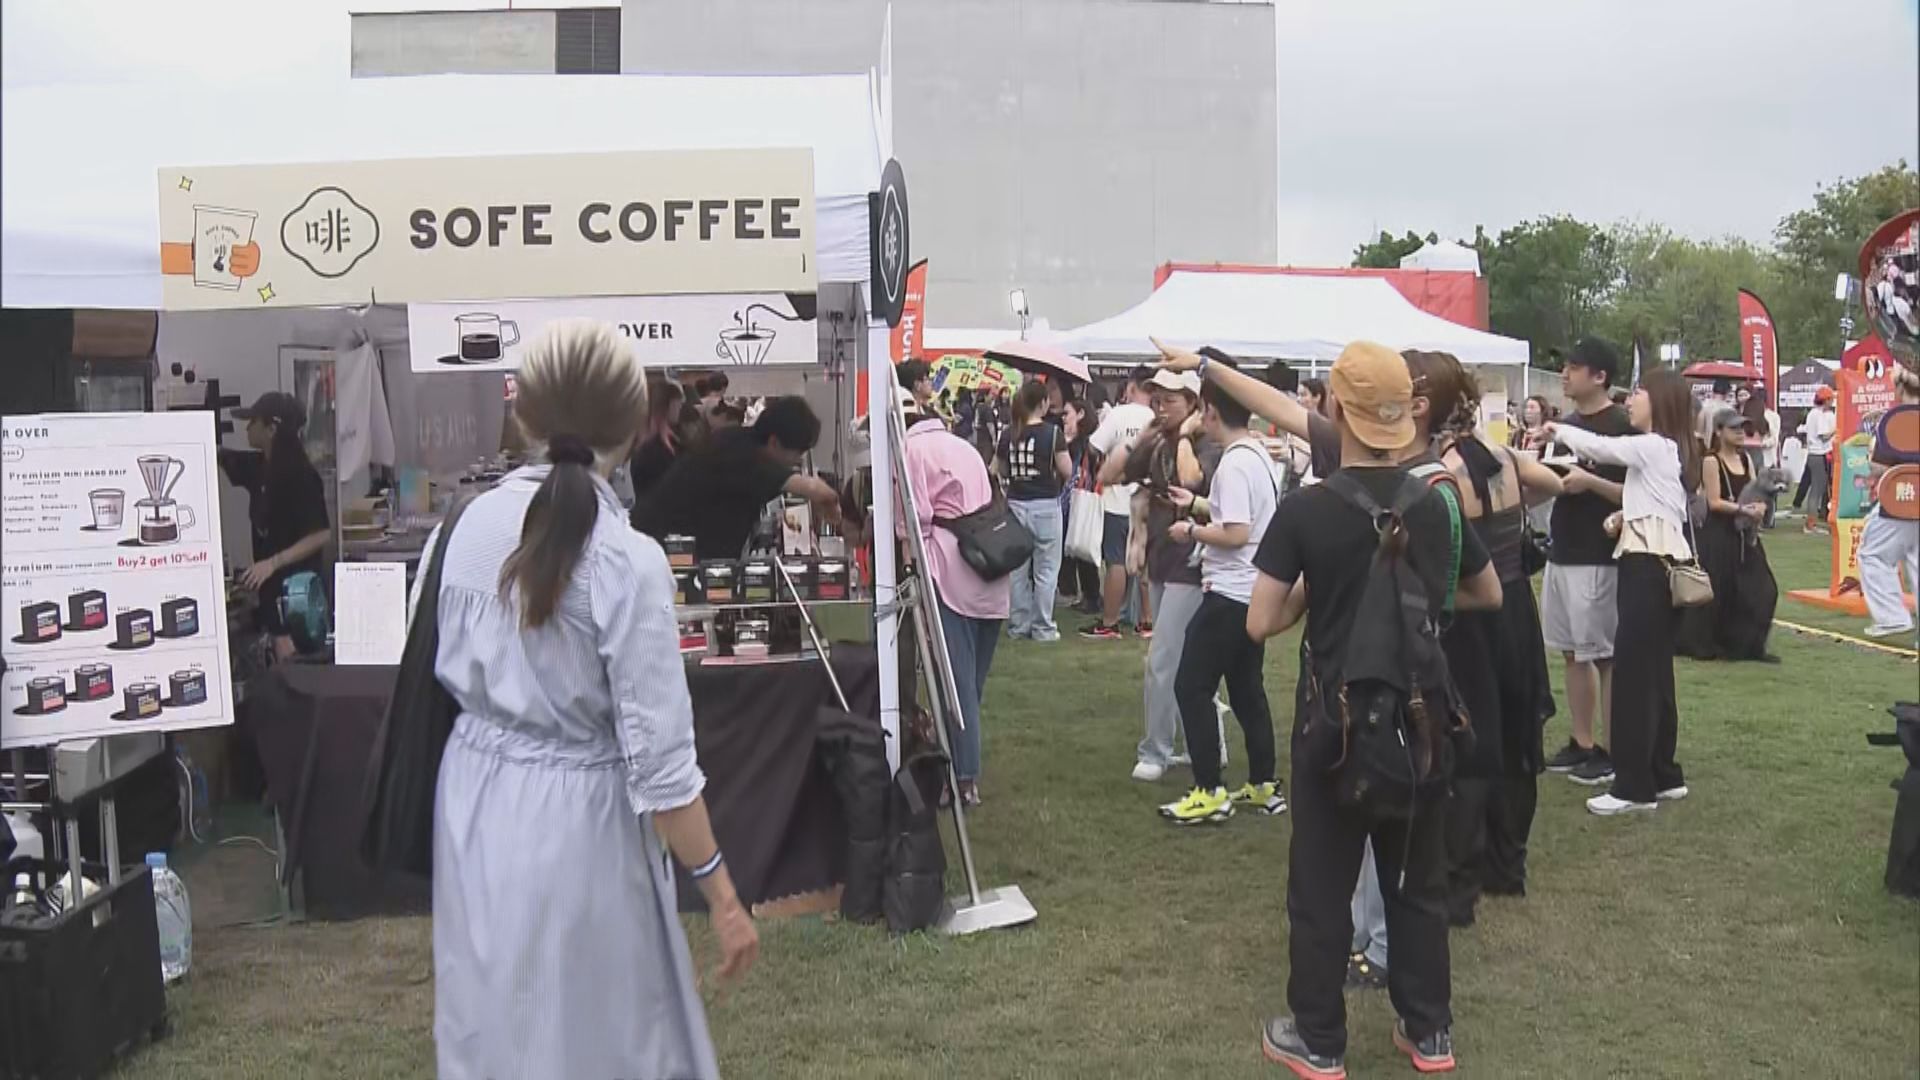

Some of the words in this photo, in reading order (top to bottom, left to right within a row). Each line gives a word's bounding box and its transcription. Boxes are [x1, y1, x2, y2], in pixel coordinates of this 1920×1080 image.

[409, 204, 553, 249] SOFE
[577, 197, 803, 243] COFFEE
[306, 207, 352, 254] 啡
[15, 427, 49, 438] OVER
[9, 469, 61, 480] Premium
[150, 556, 167, 568] get
